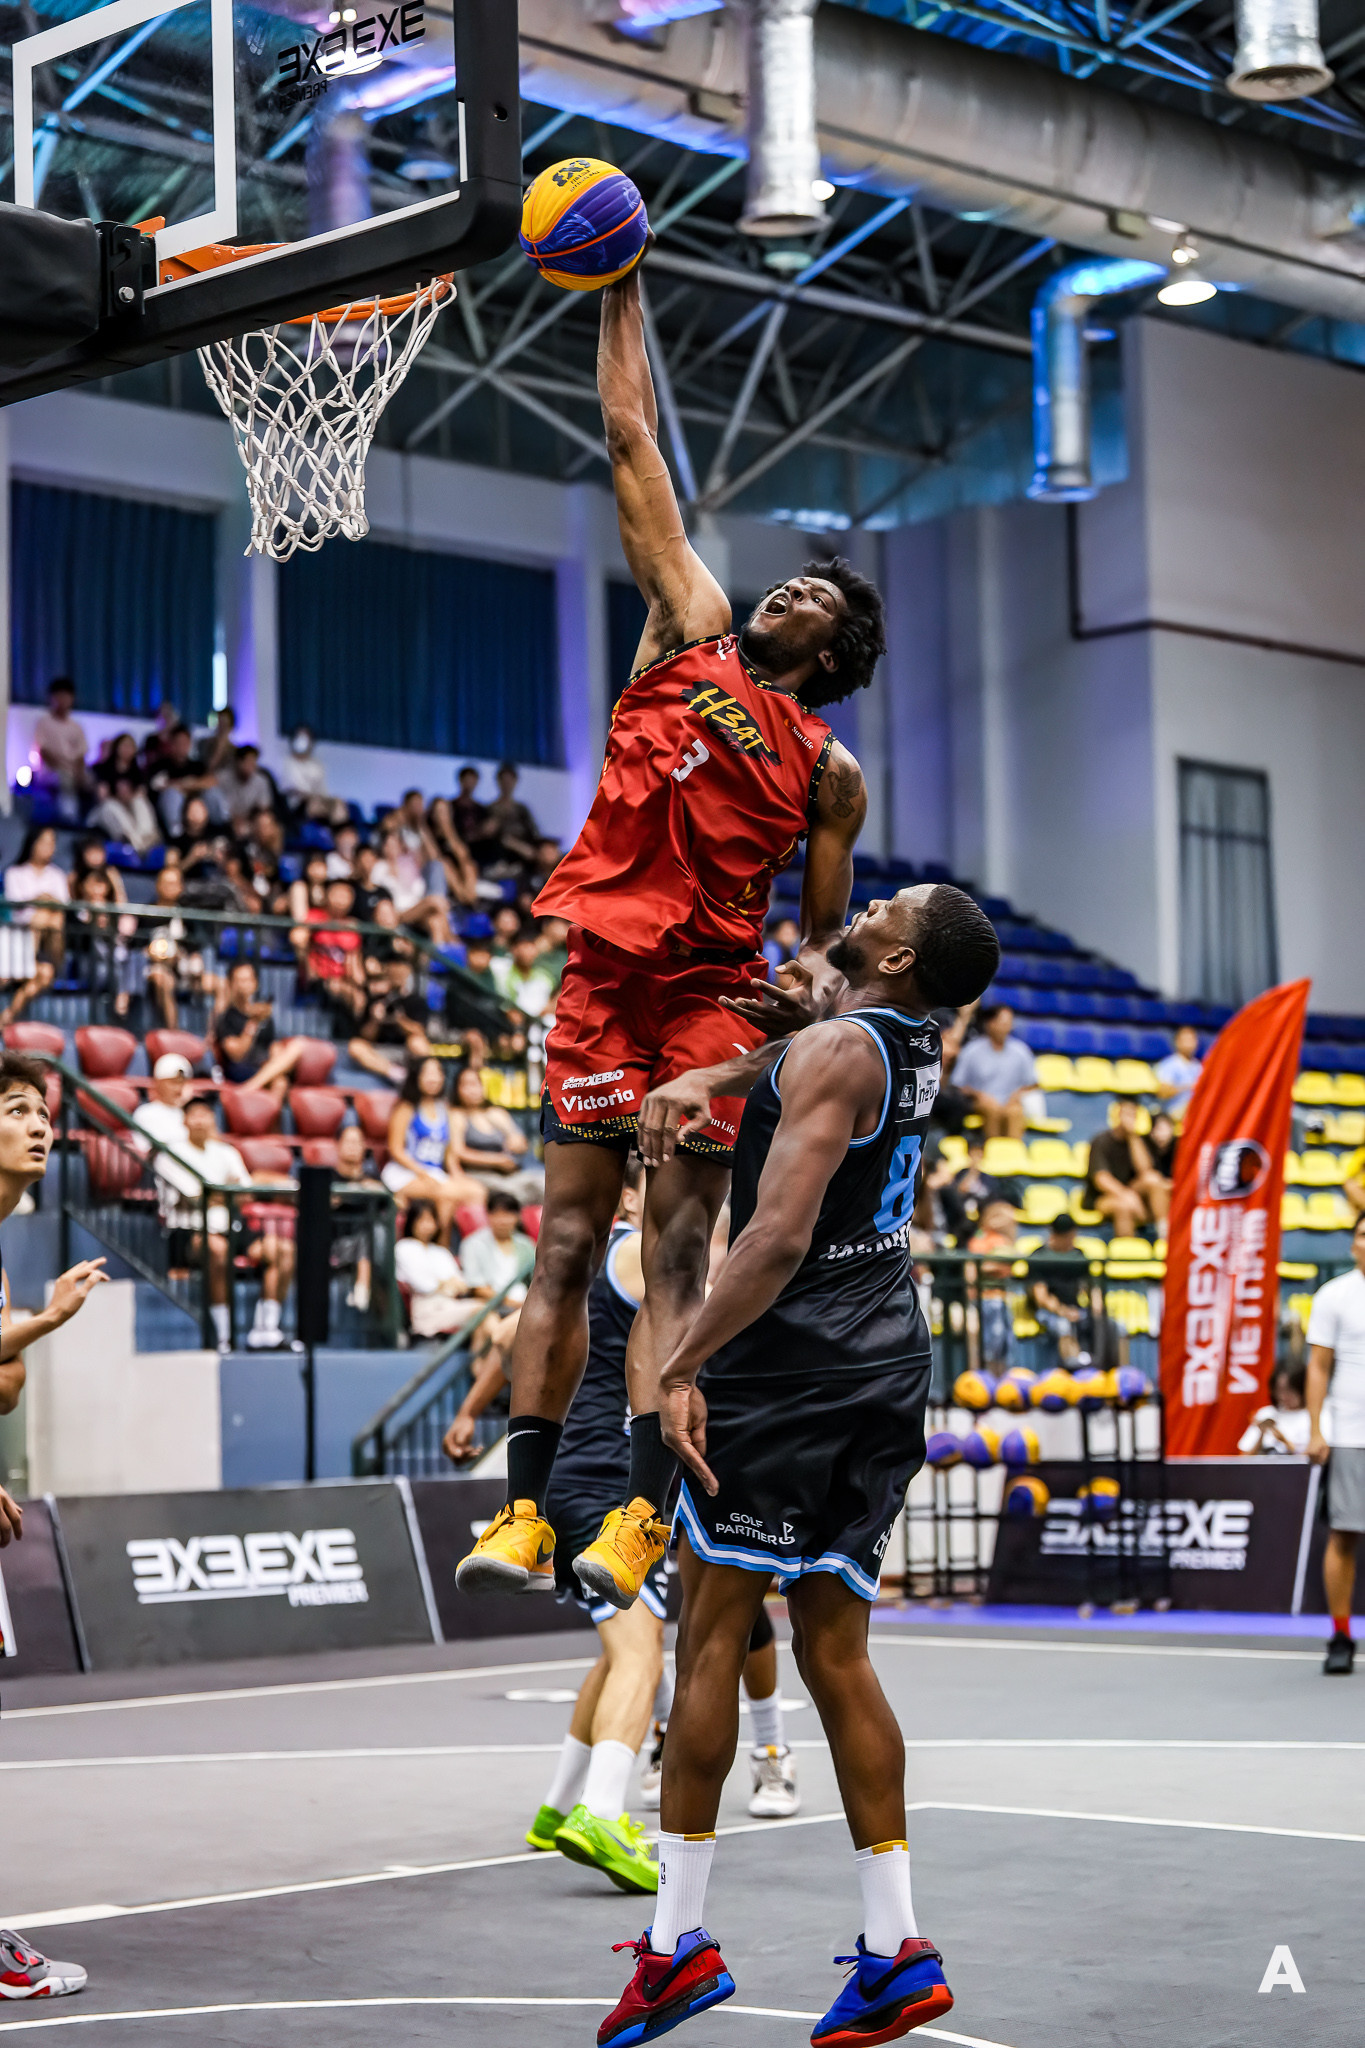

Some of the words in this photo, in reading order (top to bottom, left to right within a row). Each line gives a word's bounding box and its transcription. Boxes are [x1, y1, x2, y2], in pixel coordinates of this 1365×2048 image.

[670, 738, 710, 782] 3
[561, 1088, 635, 1112] Victoria
[721, 1121, 736, 1136] Life
[873, 1135, 921, 1233] 8
[729, 1512, 764, 1528] GOLF
[715, 1523, 777, 1545] PARTNER
